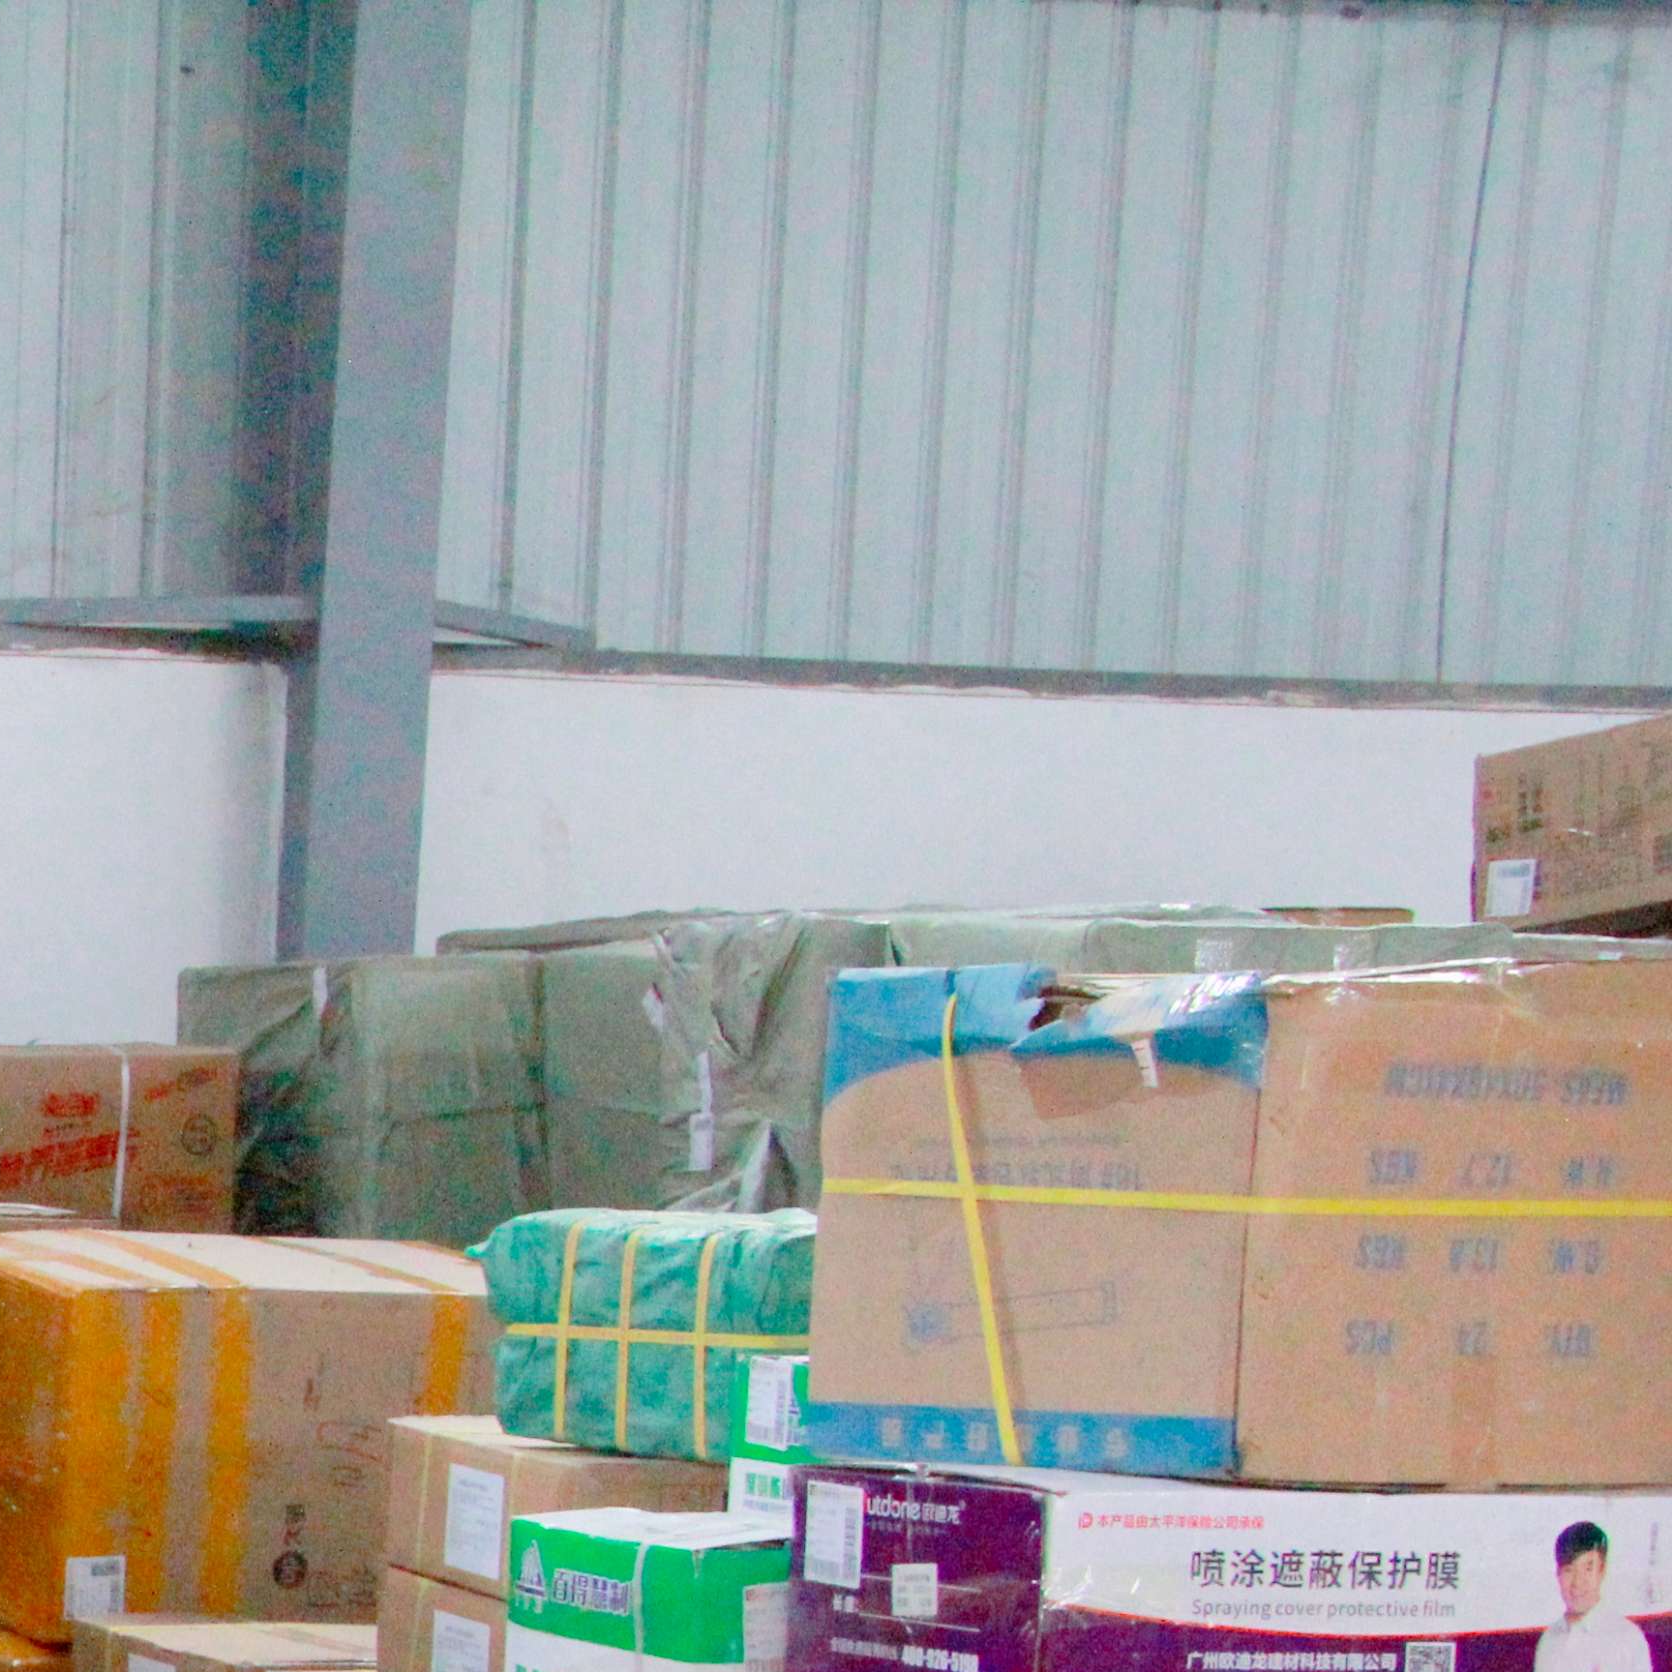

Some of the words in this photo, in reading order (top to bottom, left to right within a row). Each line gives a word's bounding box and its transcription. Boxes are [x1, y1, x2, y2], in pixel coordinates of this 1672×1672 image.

[867, 1495, 921, 1520] utdone
[1190, 1549, 1462, 1592] 喷涂遮蔽保护膜
[1192, 1599, 1271, 1620] Spraying
[1275, 1603, 1324, 1617] cover
[1327, 1601, 1418, 1619] protective
[1422, 1600, 1456, 1617] film
